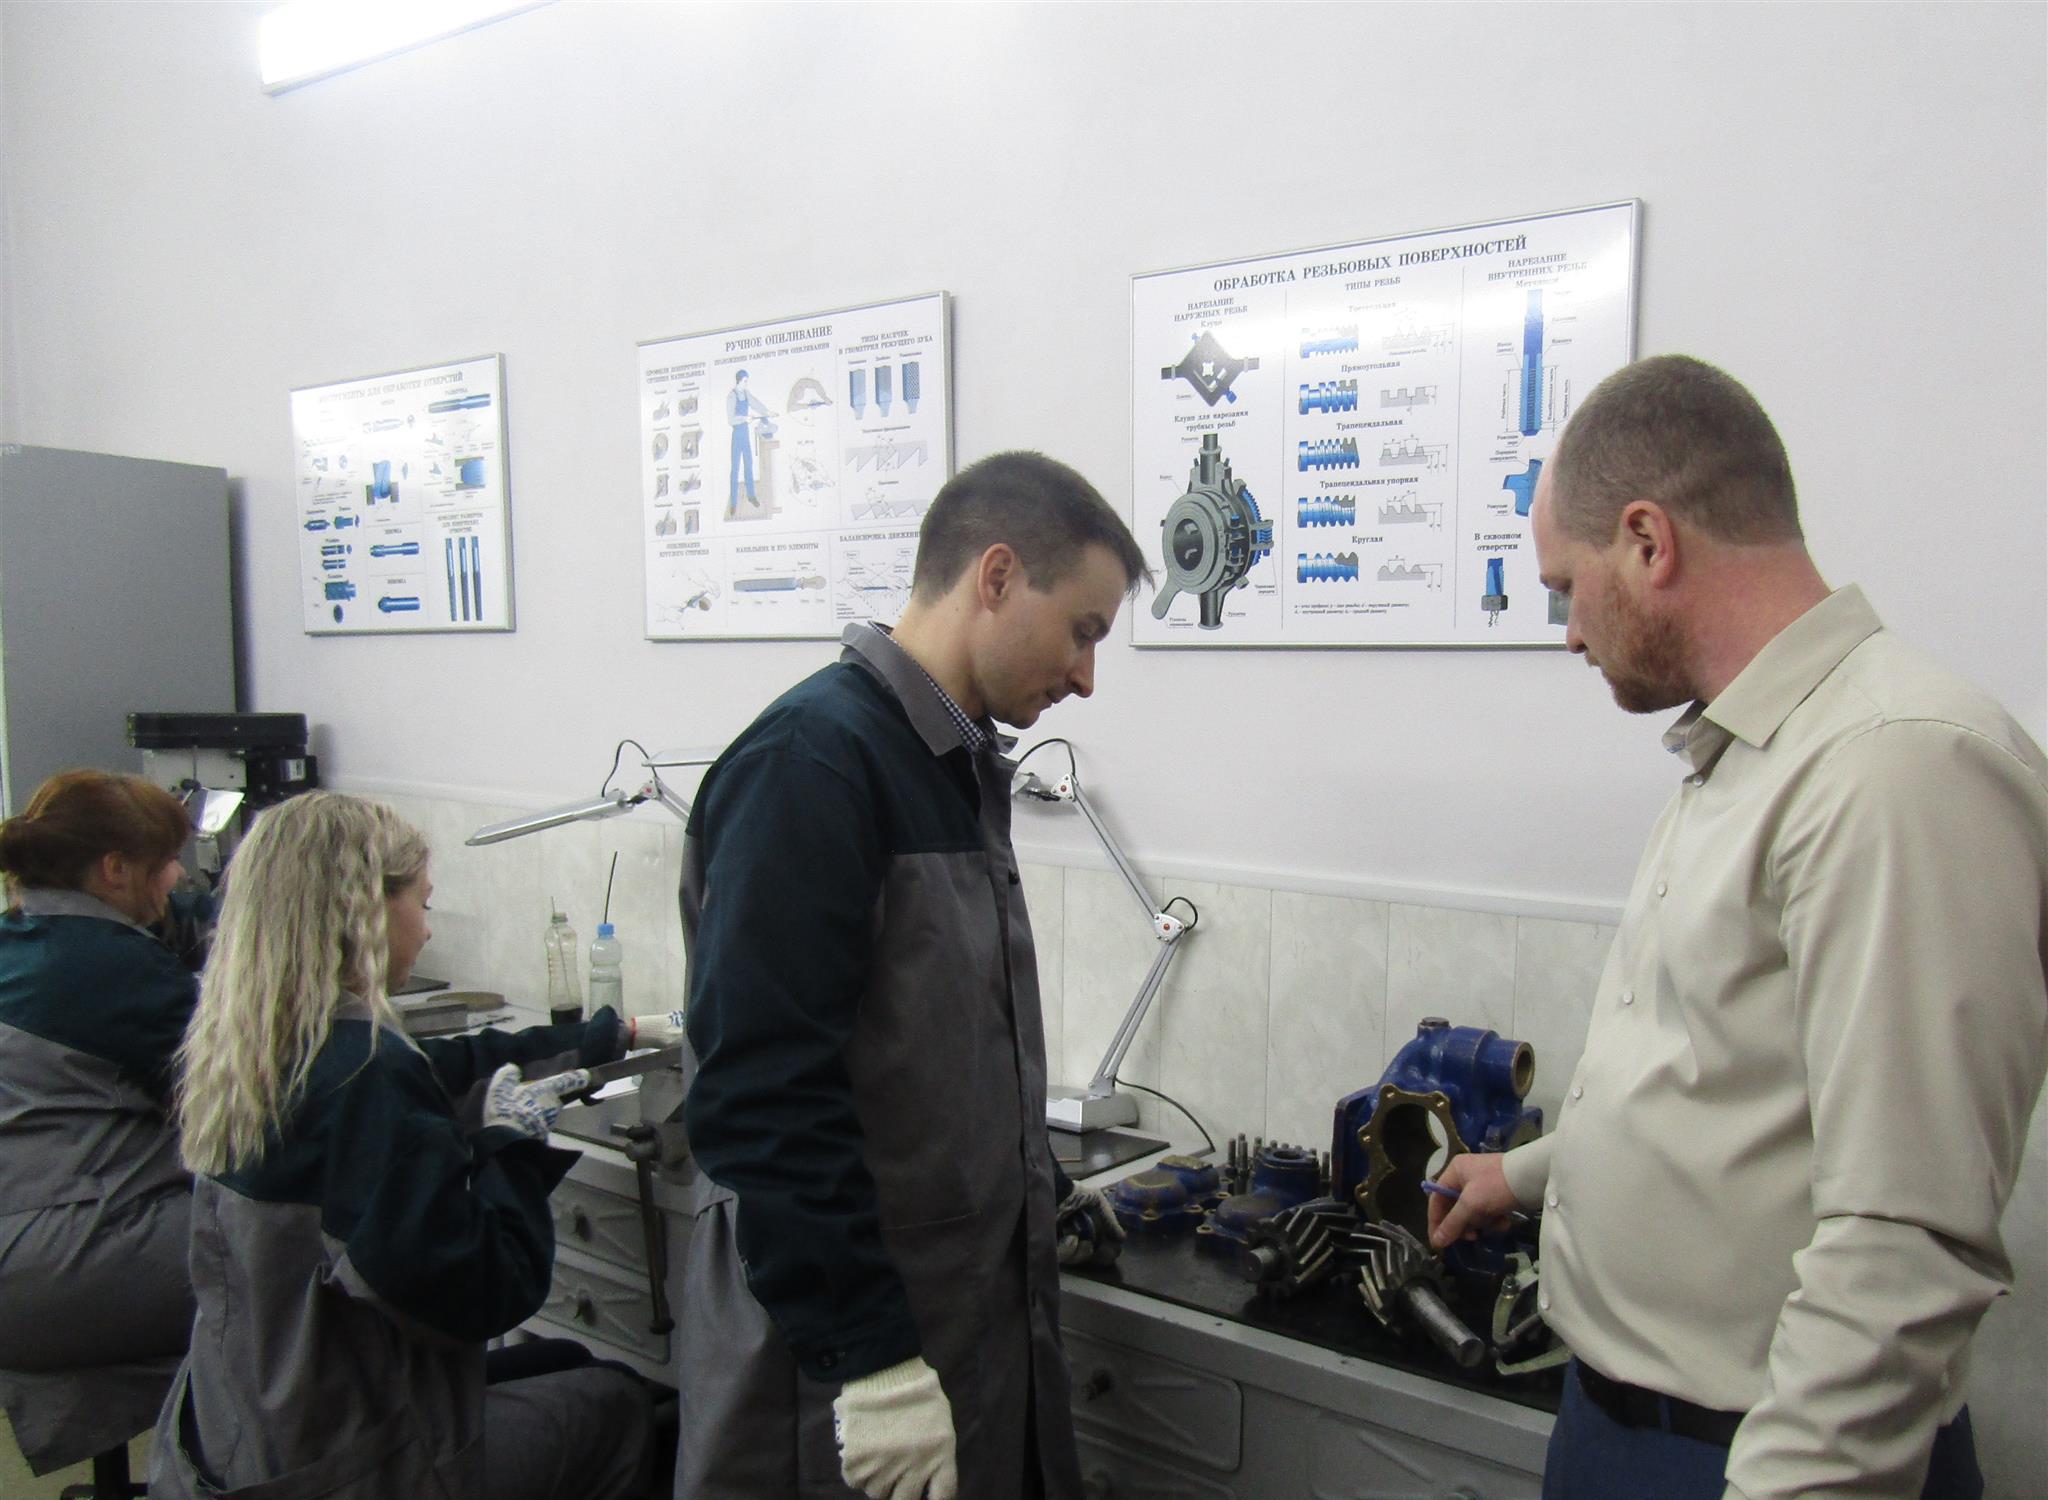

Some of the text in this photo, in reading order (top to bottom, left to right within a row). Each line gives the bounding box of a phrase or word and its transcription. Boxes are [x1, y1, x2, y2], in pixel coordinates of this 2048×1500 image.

[1213, 234, 1527, 292] ОБРАБОТКА РЕЗЬБОВЫХ ПОВЕРХНОСТЕЙ
[725, 325, 833, 352] РУЧНОЕ ОПИЛИВАНИЕ
